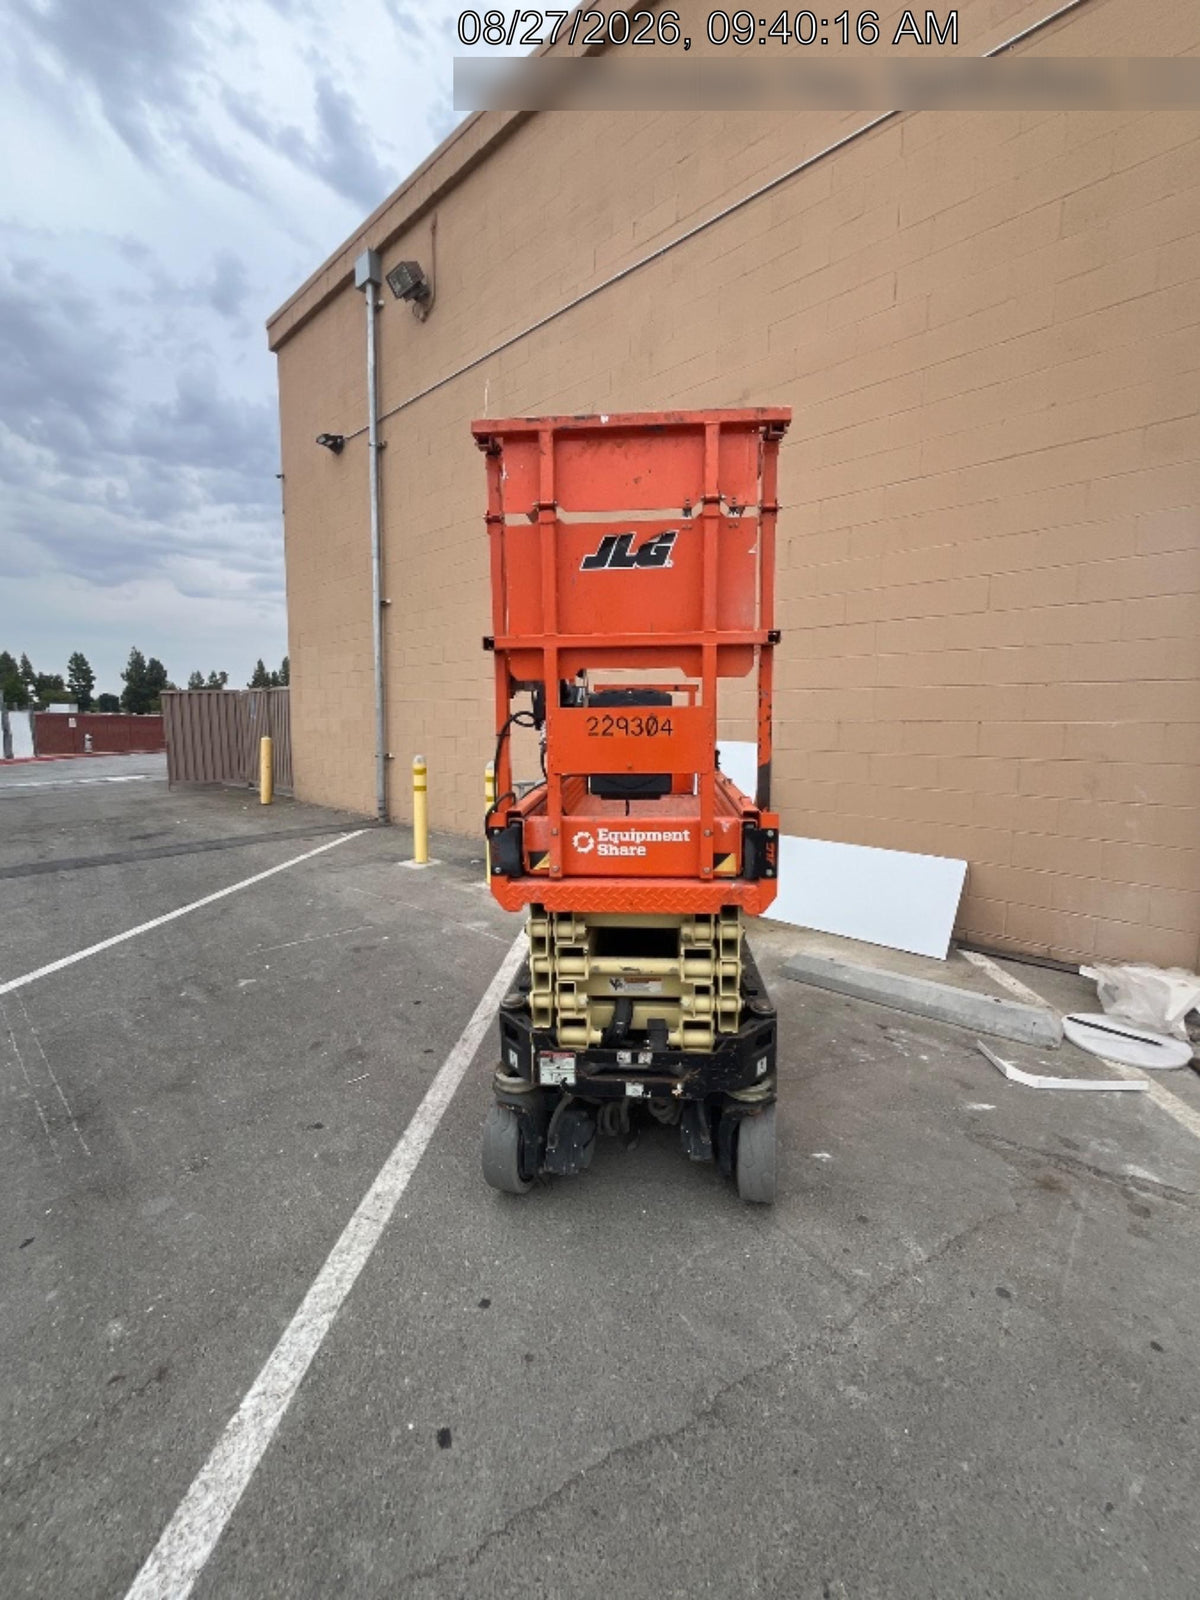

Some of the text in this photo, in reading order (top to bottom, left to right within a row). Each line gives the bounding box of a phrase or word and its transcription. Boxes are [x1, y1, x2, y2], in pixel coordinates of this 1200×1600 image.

[579, 529, 679, 571] JLG
[586, 714, 672, 736] 229304
[597, 828, 690, 844] Equipment
[597, 844, 646, 856] Share
